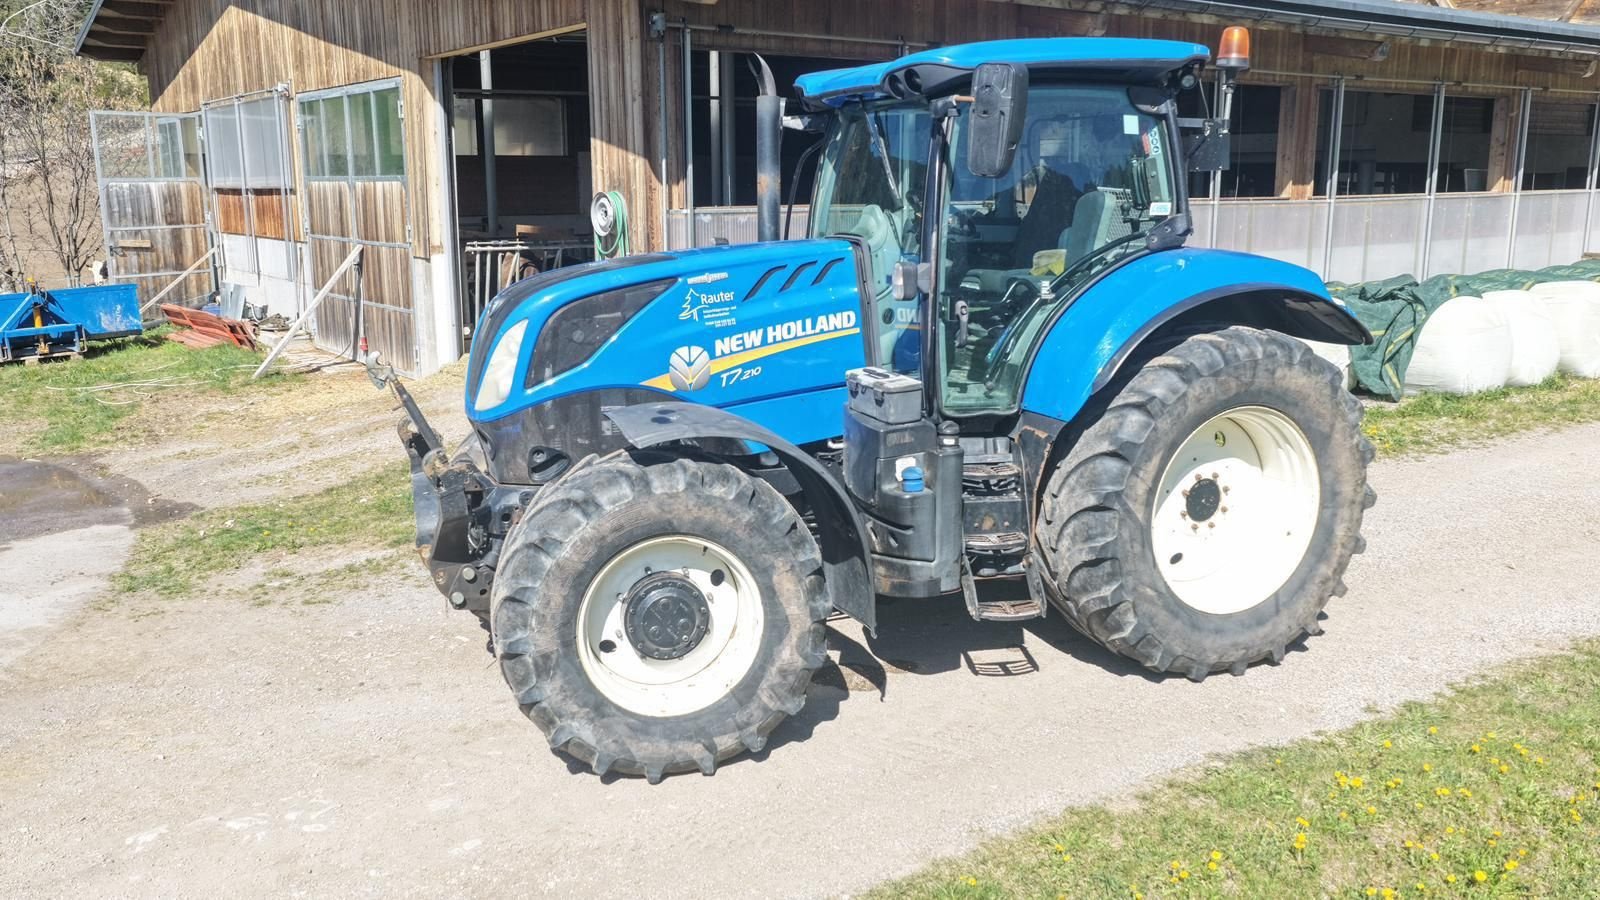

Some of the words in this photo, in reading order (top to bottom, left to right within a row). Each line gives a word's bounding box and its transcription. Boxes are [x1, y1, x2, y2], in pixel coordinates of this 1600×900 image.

[700, 291, 735, 304] Rauter
[715, 329, 763, 357] NEW
[767, 311, 856, 344] HOLLAND
[720, 366, 762, 387] T7.210
